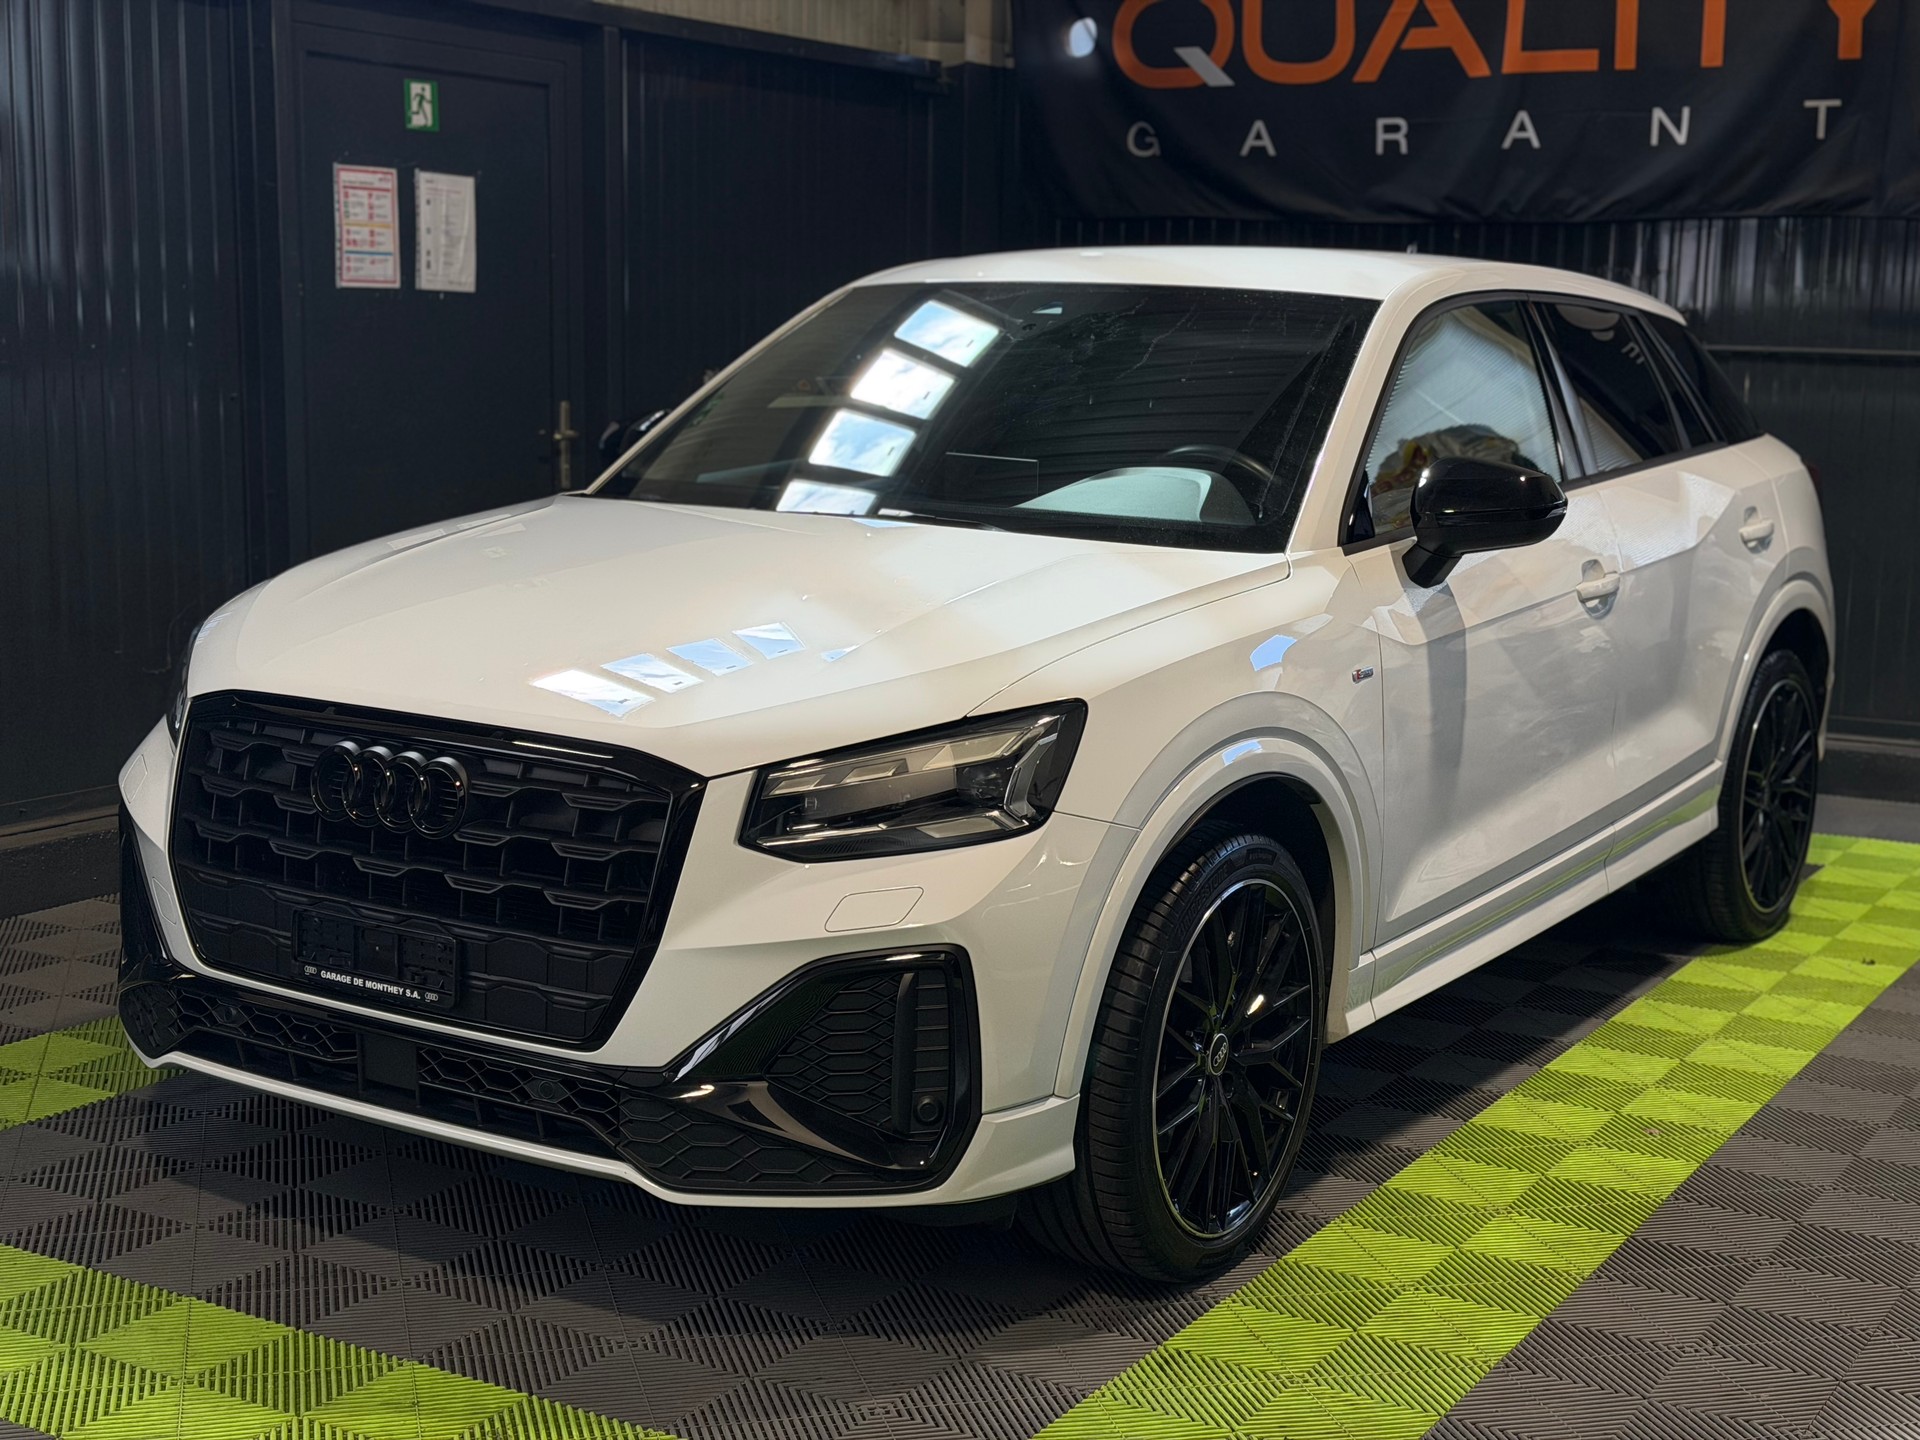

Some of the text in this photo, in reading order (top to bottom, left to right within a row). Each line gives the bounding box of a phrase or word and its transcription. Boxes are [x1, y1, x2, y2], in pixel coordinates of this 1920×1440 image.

[1126, 99, 1842, 157] GARANT
[320, 970, 421, 999] GARAGE DE MONTHEY S.A.
